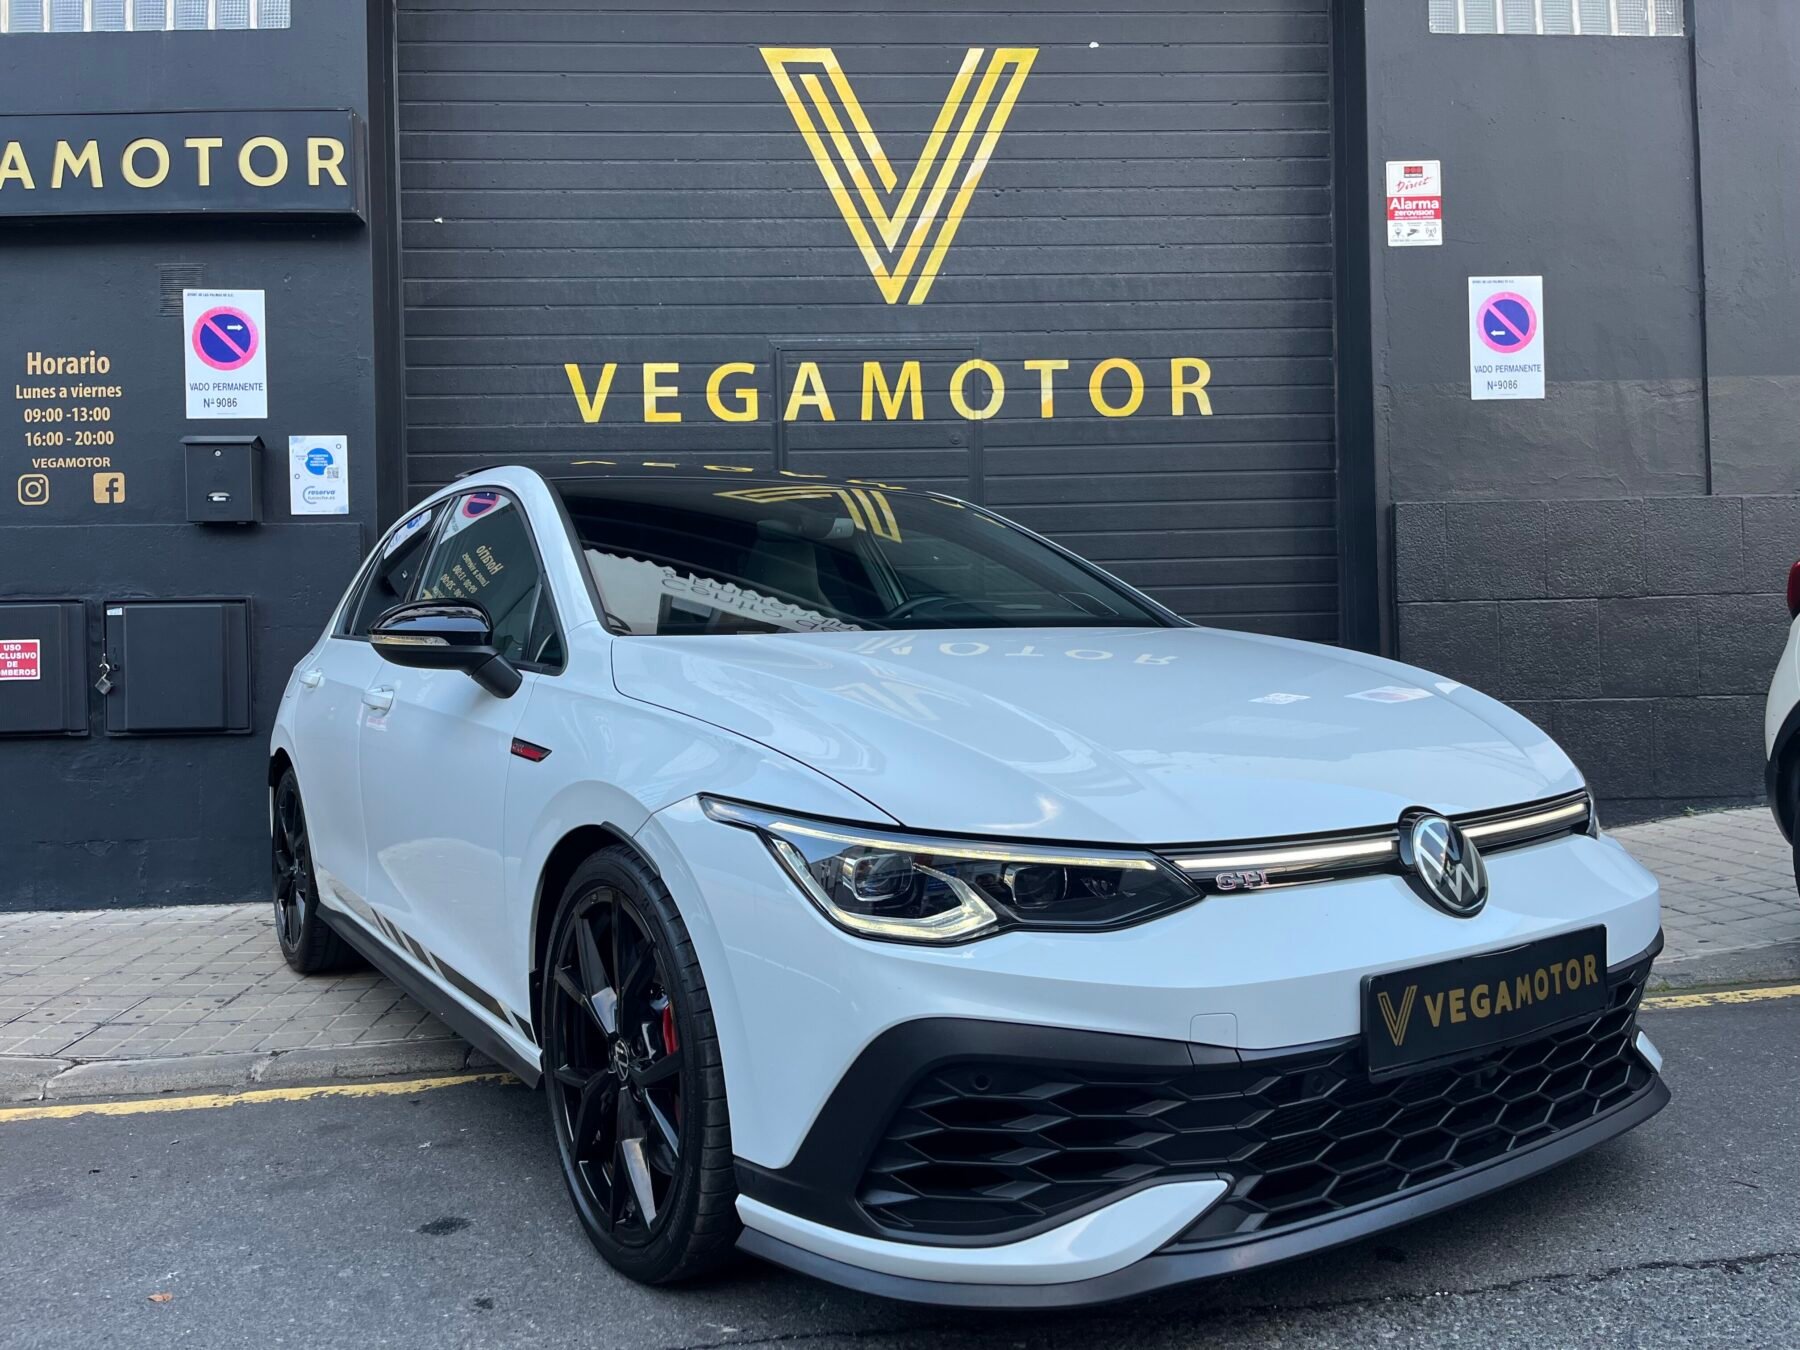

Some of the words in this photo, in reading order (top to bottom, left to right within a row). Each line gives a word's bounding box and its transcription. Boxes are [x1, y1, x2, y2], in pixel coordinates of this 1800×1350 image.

[0, 136, 348, 190] AMOTOR
[1390, 197, 1441, 210] Alarma
[1394, 209, 1435, 217] zerovision
[27, 350, 111, 375] Horario
[1474, 364, 1493, 373] VADO
[1495, 363, 1542, 373] PERMANENTE
[15, 384, 56, 399] Lunes
[59, 386, 68, 398] a
[71, 382, 122, 398] viernes
[189, 382, 210, 391] VADO
[212, 382, 264, 391] PERMANENTE
[564, 357, 1214, 424] VEGAMOTOR
[24, 408, 63, 423] 09:00
[24, 431, 64, 447] 16:00
[74, 430, 114, 446] 20:00
[31, 457, 111, 468] VEGAMOTOR
[6, 660, 19, 668] DE
[1215, 868, 1269, 890] GTI
[1424, 954, 1599, 1027] VEGAMOTOR
